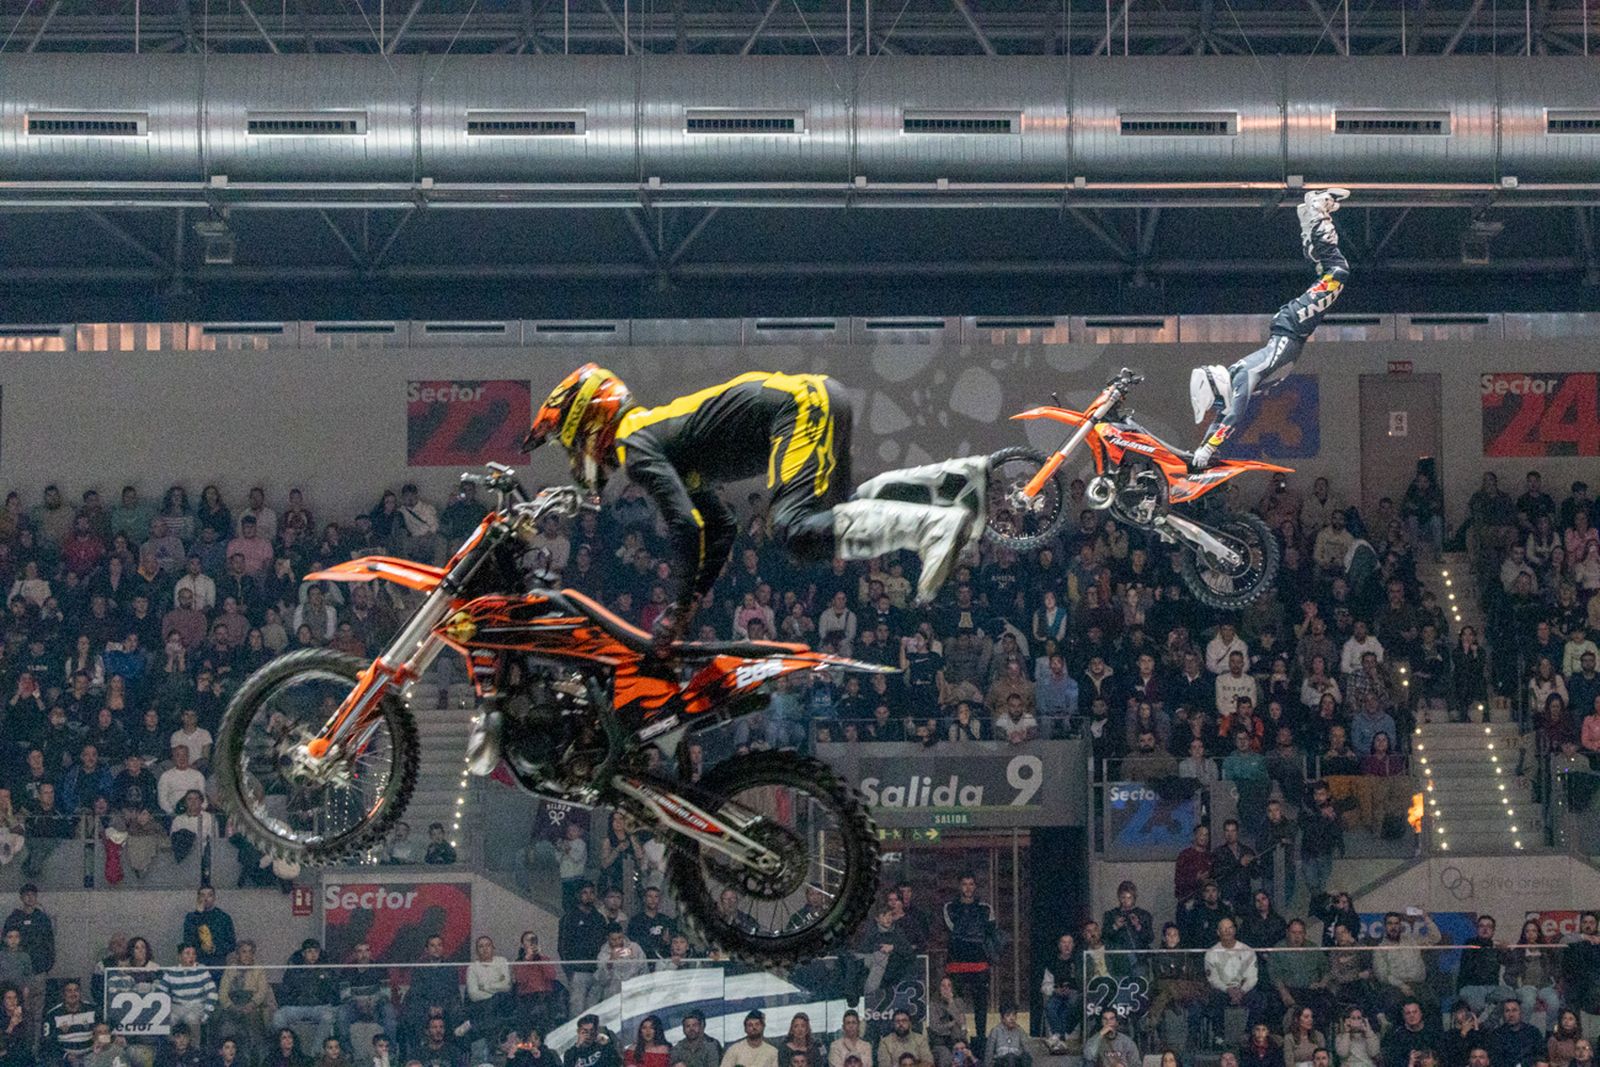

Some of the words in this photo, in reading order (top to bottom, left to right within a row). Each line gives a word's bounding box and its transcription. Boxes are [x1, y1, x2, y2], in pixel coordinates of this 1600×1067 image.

[407, 382, 486, 402] Sector
[1481, 374, 1557, 395] Sector
[1482, 373, 1600, 457] 24
[860, 776, 984, 807] Salida
[1006, 755, 1043, 806] 9
[1110, 786, 1159, 801] Secto
[935, 815, 968, 824] SALIDA
[323, 885, 418, 910] Sector
[864, 980, 928, 1022] 23
[1087, 975, 1149, 1019] 23
[111, 992, 171, 1035] 22
[115, 1021, 153, 1032] ector
